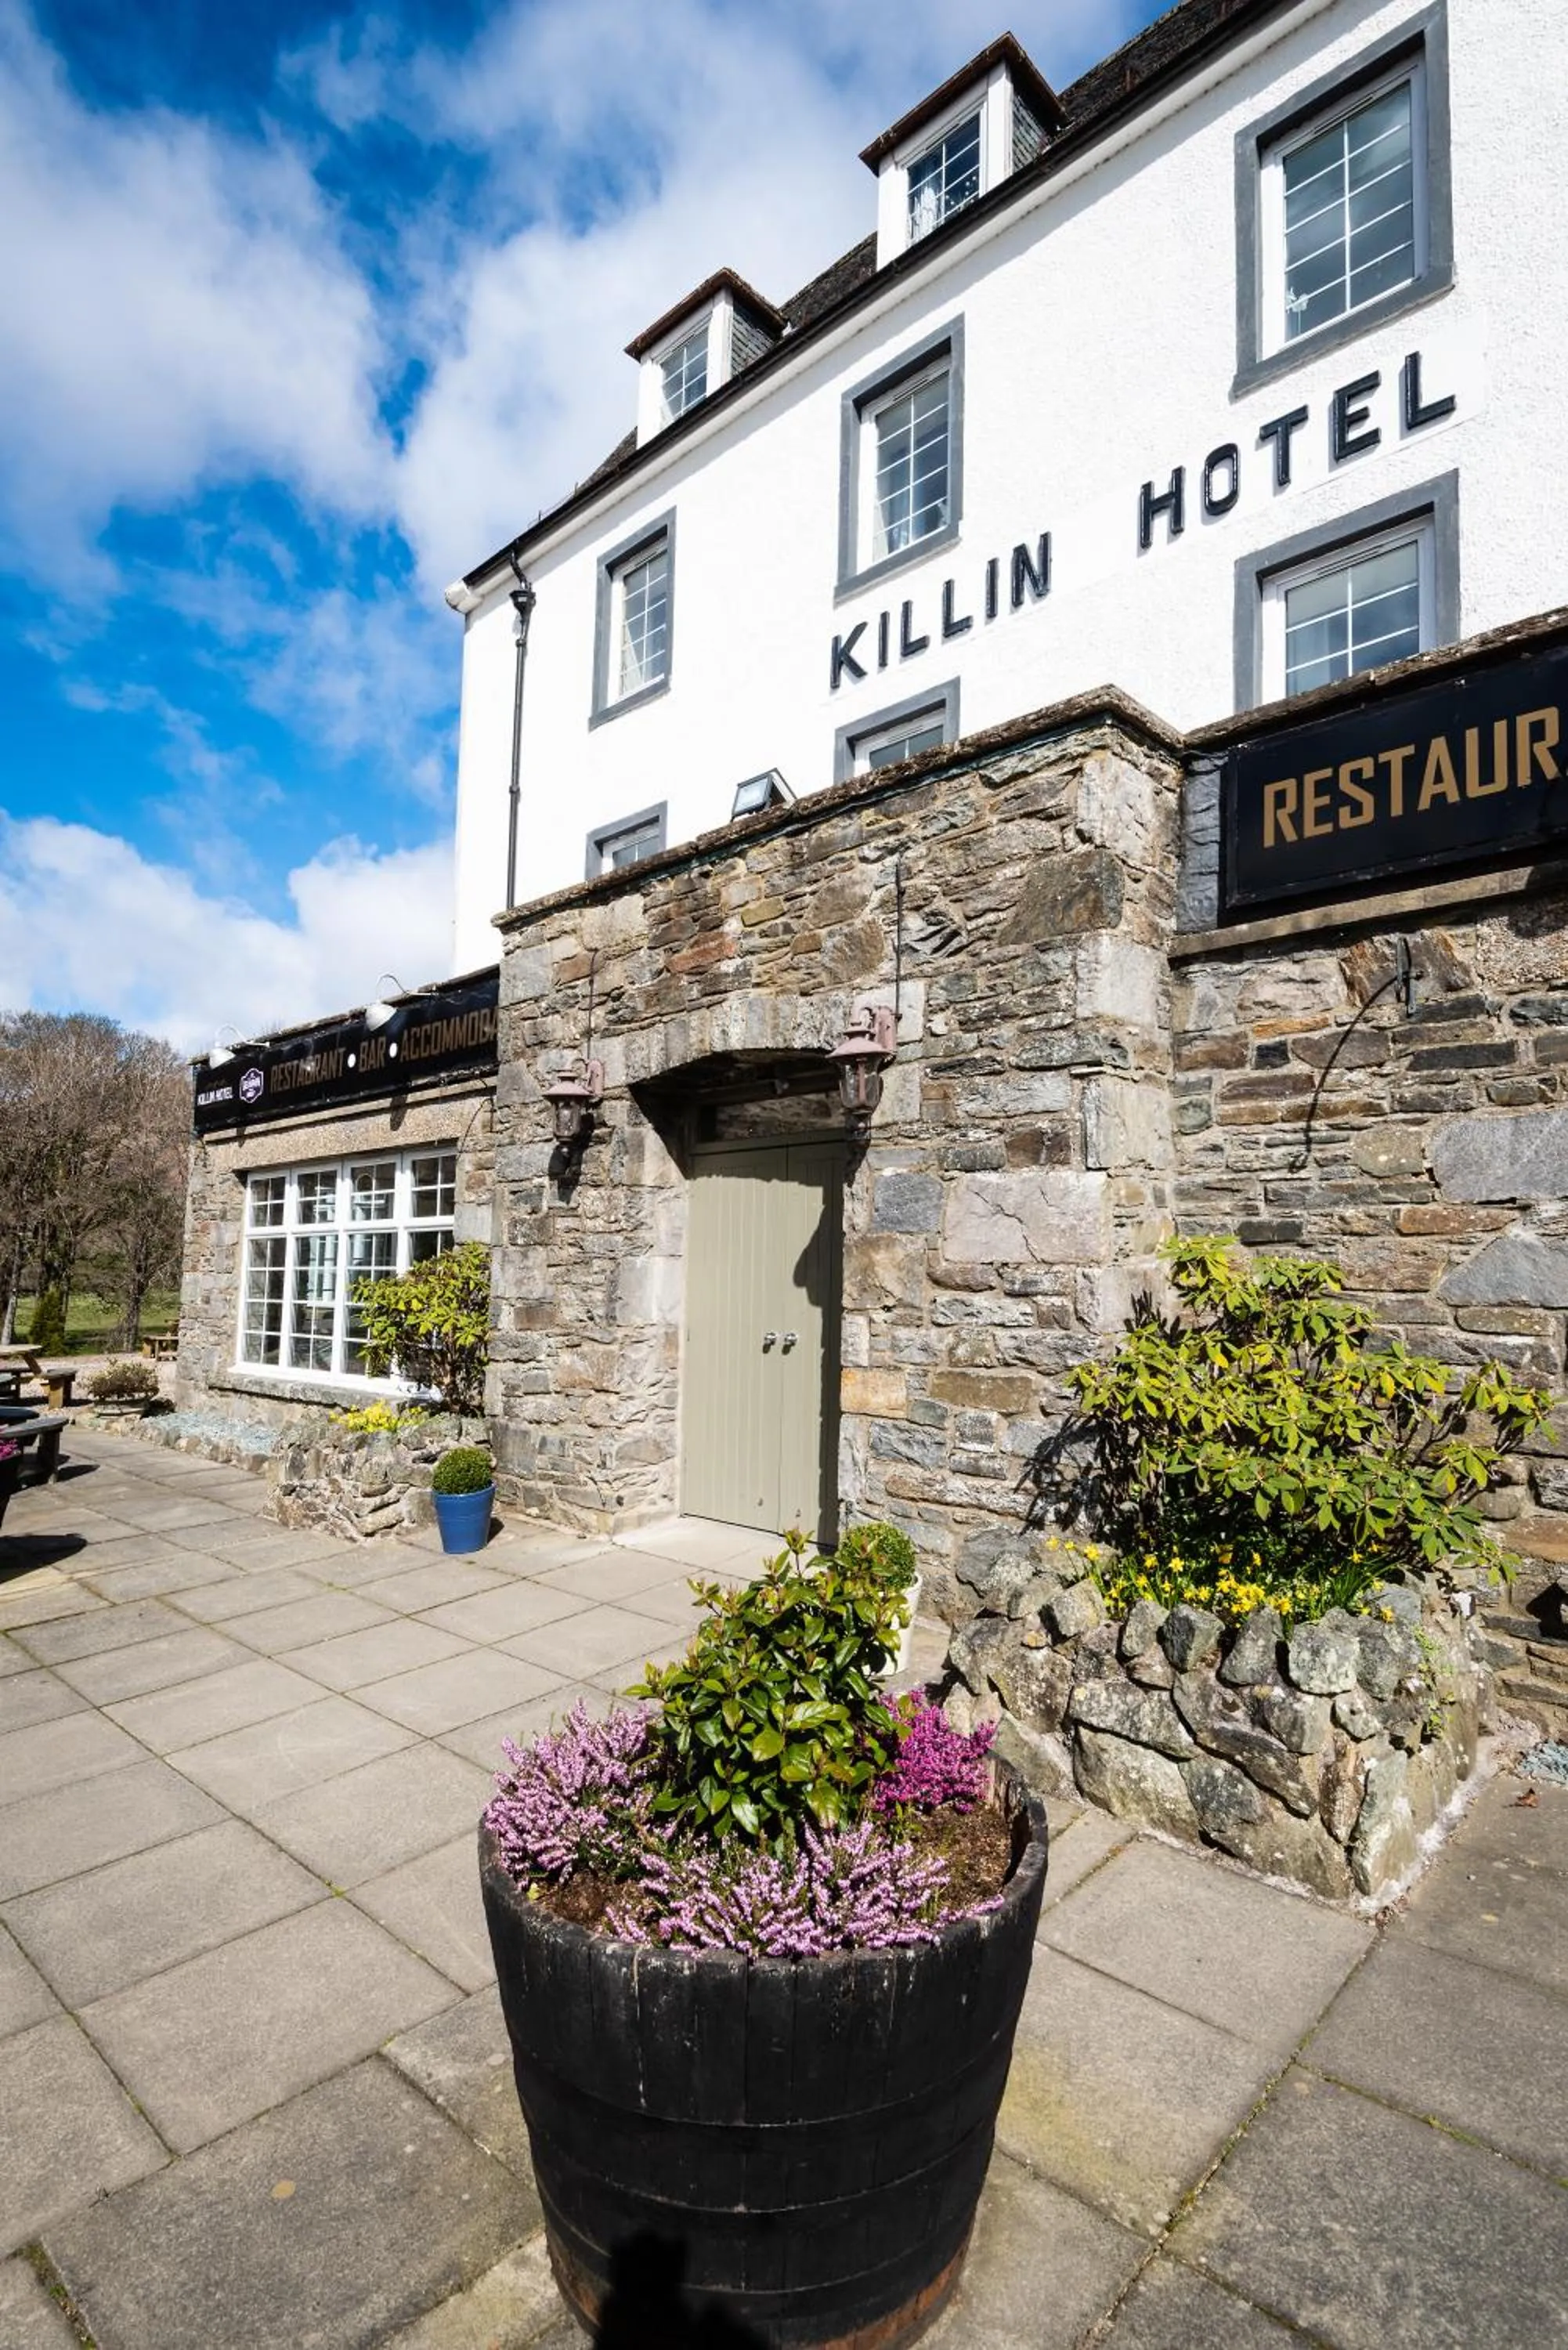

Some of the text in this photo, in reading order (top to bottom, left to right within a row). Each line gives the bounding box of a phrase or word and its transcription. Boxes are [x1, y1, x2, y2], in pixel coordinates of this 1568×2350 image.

[829, 350, 1457, 690] KILLIN HOTEL
[1263, 706, 1560, 849] RESTAUR
[269, 1047, 346, 1094] RESTAURANT
[358, 1036, 387, 1072] BAR
